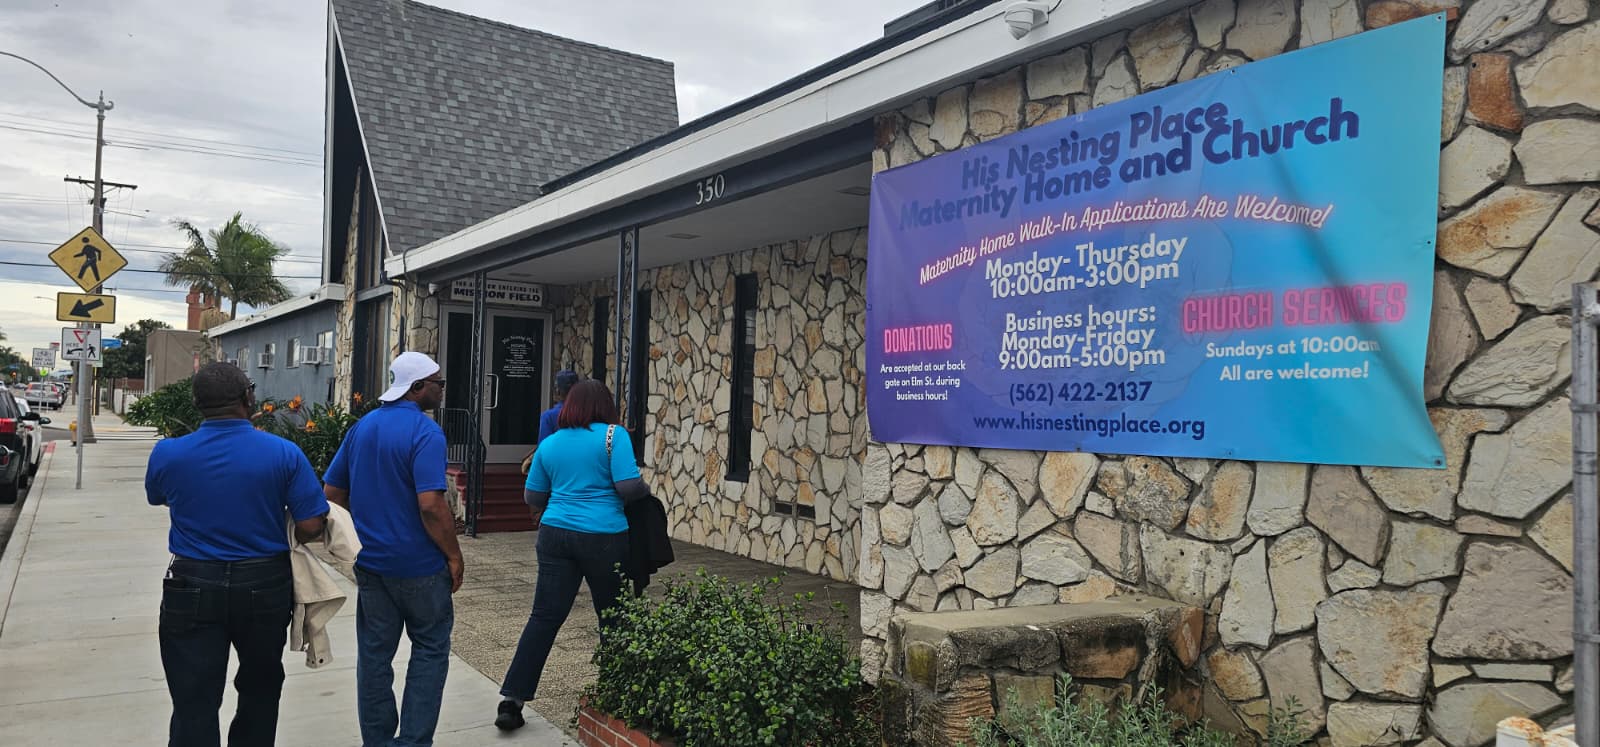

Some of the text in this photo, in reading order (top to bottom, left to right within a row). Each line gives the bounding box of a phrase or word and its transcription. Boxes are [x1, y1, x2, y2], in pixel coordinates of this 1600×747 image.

[962, 102, 1228, 190] His Nesting Place
[899, 97, 1359, 230] Maternity Home and Church
[695, 174, 725, 205] 350
[919, 194, 1334, 285] Maternity Home Walk-In Applications Are Welcome!
[985, 232, 1188, 280] Monday- Thursday
[990, 260, 1179, 299] 10:00am-3:00pm
[454, 288, 540, 302] MISON FIELD
[1005, 305, 1156, 332] Business hours:
[1183, 292, 1274, 333] CHURCH
[884, 323, 953, 353] DONATIONS
[1001, 324, 1155, 353] Monday-Friday
[1206, 336, 1381, 360] Sundays at 10:00am
[880, 364, 893, 373] Are
[894, 361, 923, 374] accepted
[924, 363, 932, 371] at
[946, 360, 966, 370] back
[998, 344, 1165, 371] 9:00am-5:00pm
[1219, 361, 1369, 381] All are welcome!
[885, 378, 900, 389] gate
[911, 376, 923, 386] Elm
[924, 376, 935, 386] St.
[936, 376, 961, 388] during
[896, 390, 948, 400] business hours!
[1009, 381, 1153, 406] (562) 422-2137
[973, 411, 1205, 440] www.hisnestingplace.org
